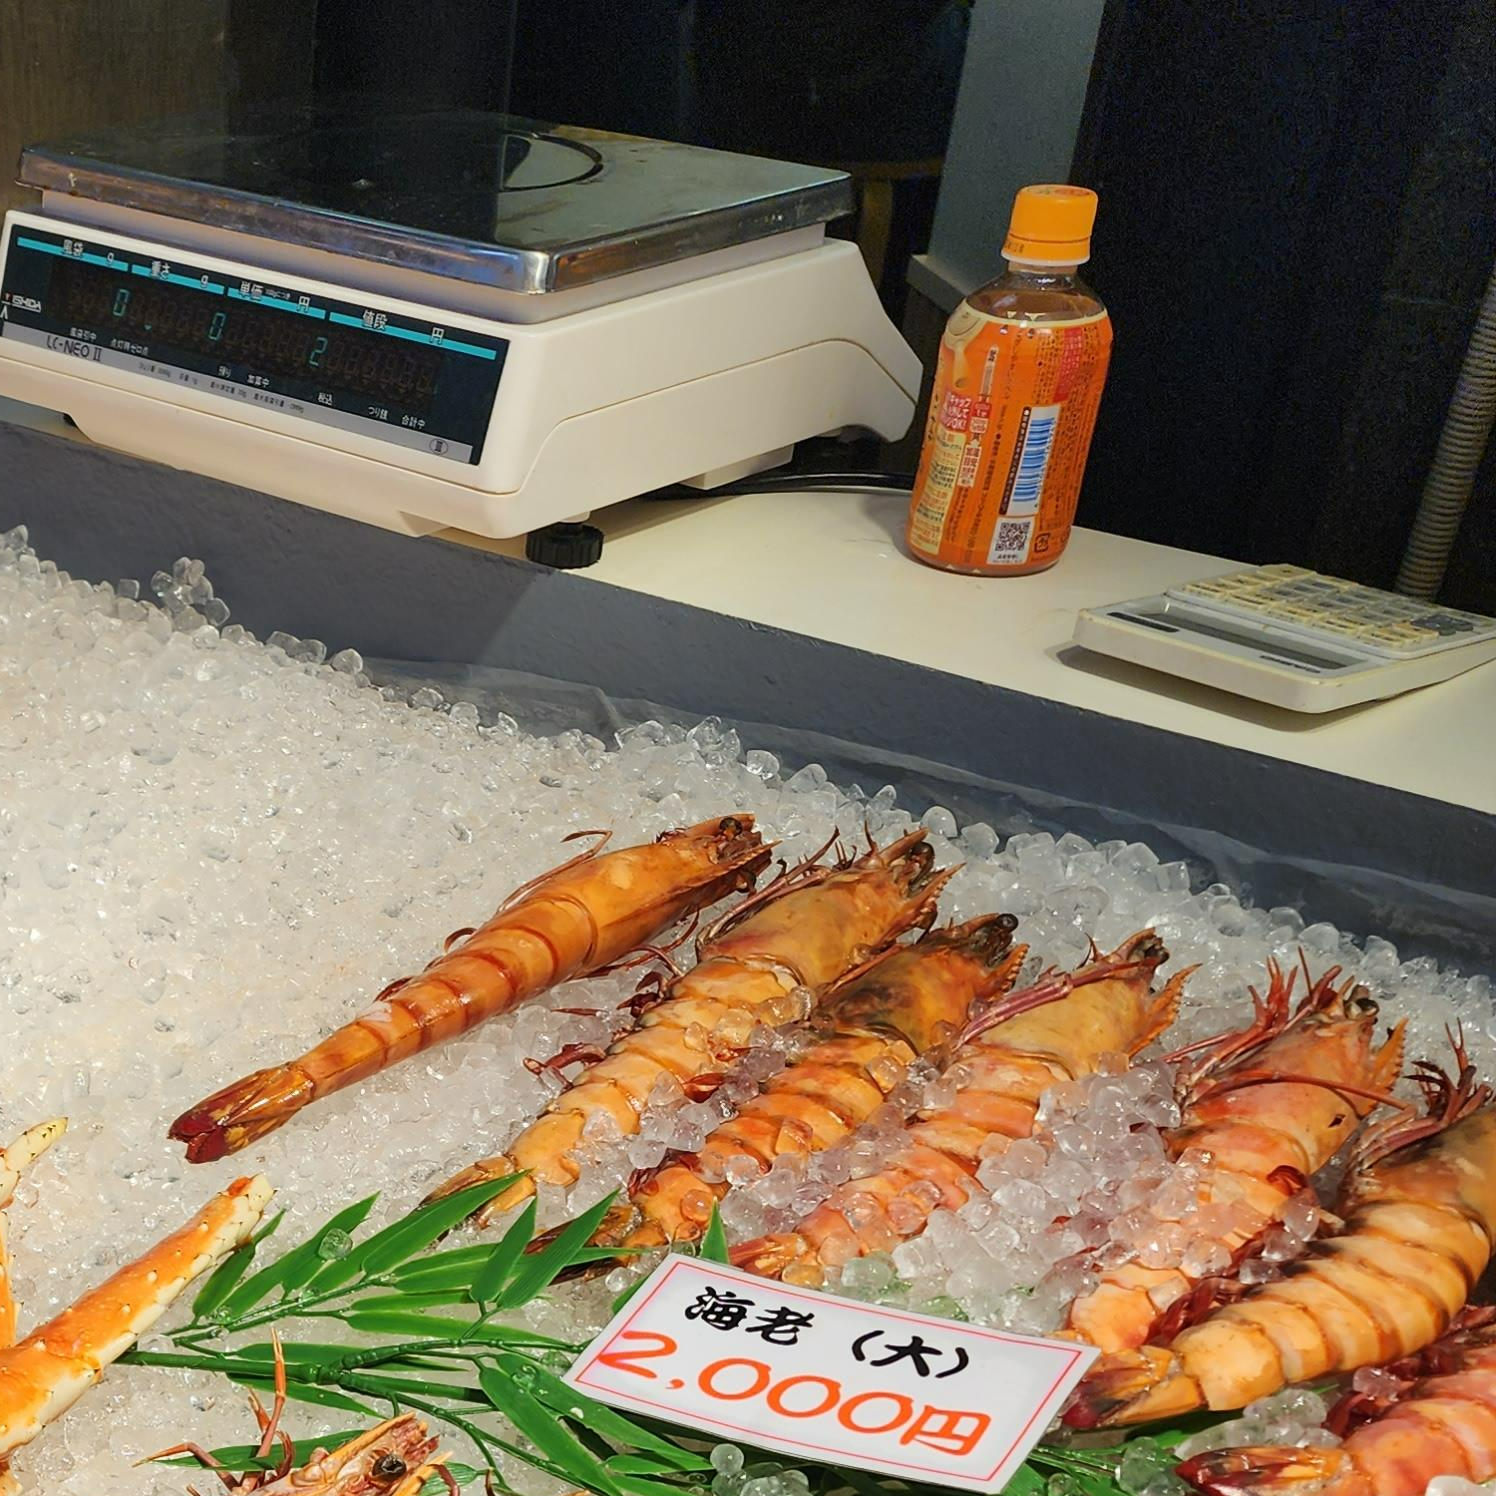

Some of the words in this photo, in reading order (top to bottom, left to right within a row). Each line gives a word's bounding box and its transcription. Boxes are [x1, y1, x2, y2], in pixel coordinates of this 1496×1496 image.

[296, 295, 311, 313] 円
[362, 308, 389, 331] 値段
[430, 326, 444, 345] 円
[595, 1329, 992, 1457] 2,000円
